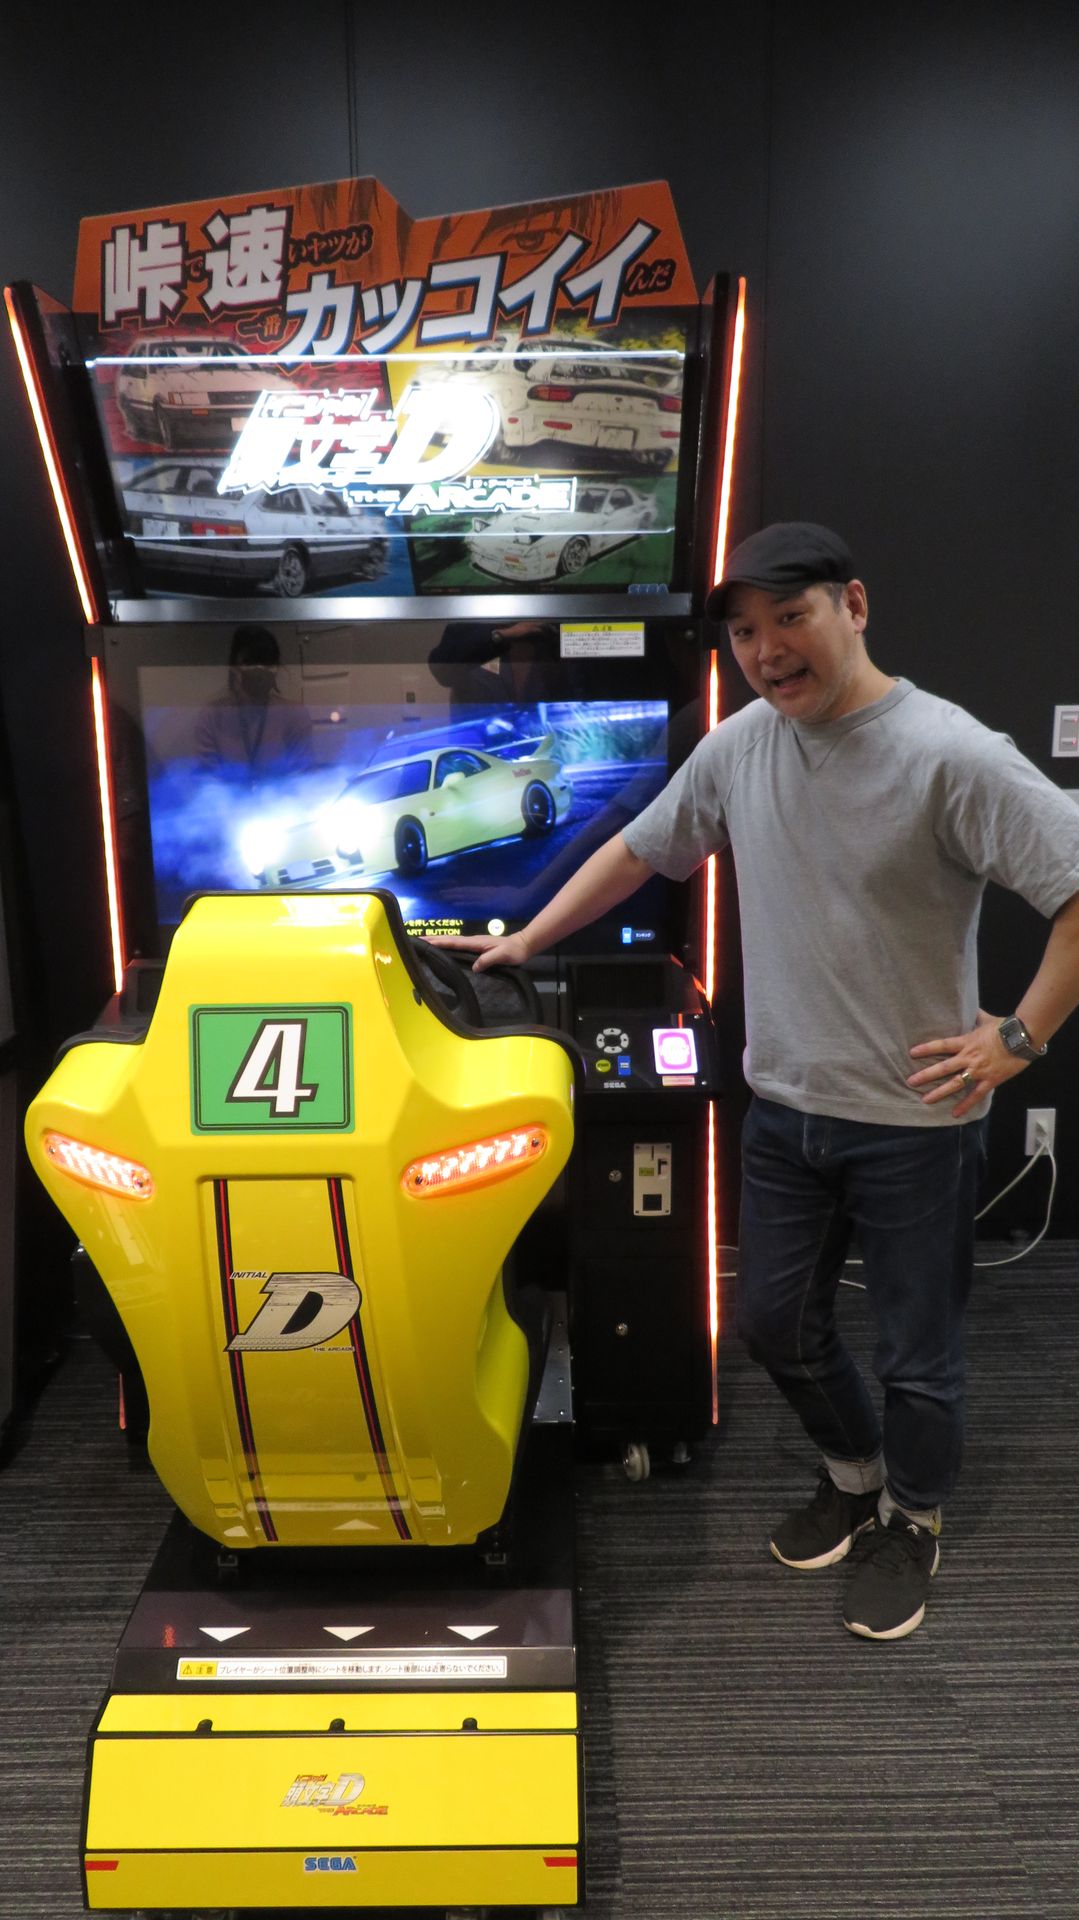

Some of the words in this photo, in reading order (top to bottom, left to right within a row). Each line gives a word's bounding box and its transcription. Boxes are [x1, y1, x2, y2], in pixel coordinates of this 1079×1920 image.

[350, 490, 400, 503] THE
[398, 484, 571, 511] ARCADE
[425, 928, 461, 936] BUTTON
[225, 1018, 319, 1118] 4
[231, 1271, 268, 1279] INITIAL
[223, 1271, 363, 1352] D
[304, 1856, 357, 1871] SEGA
